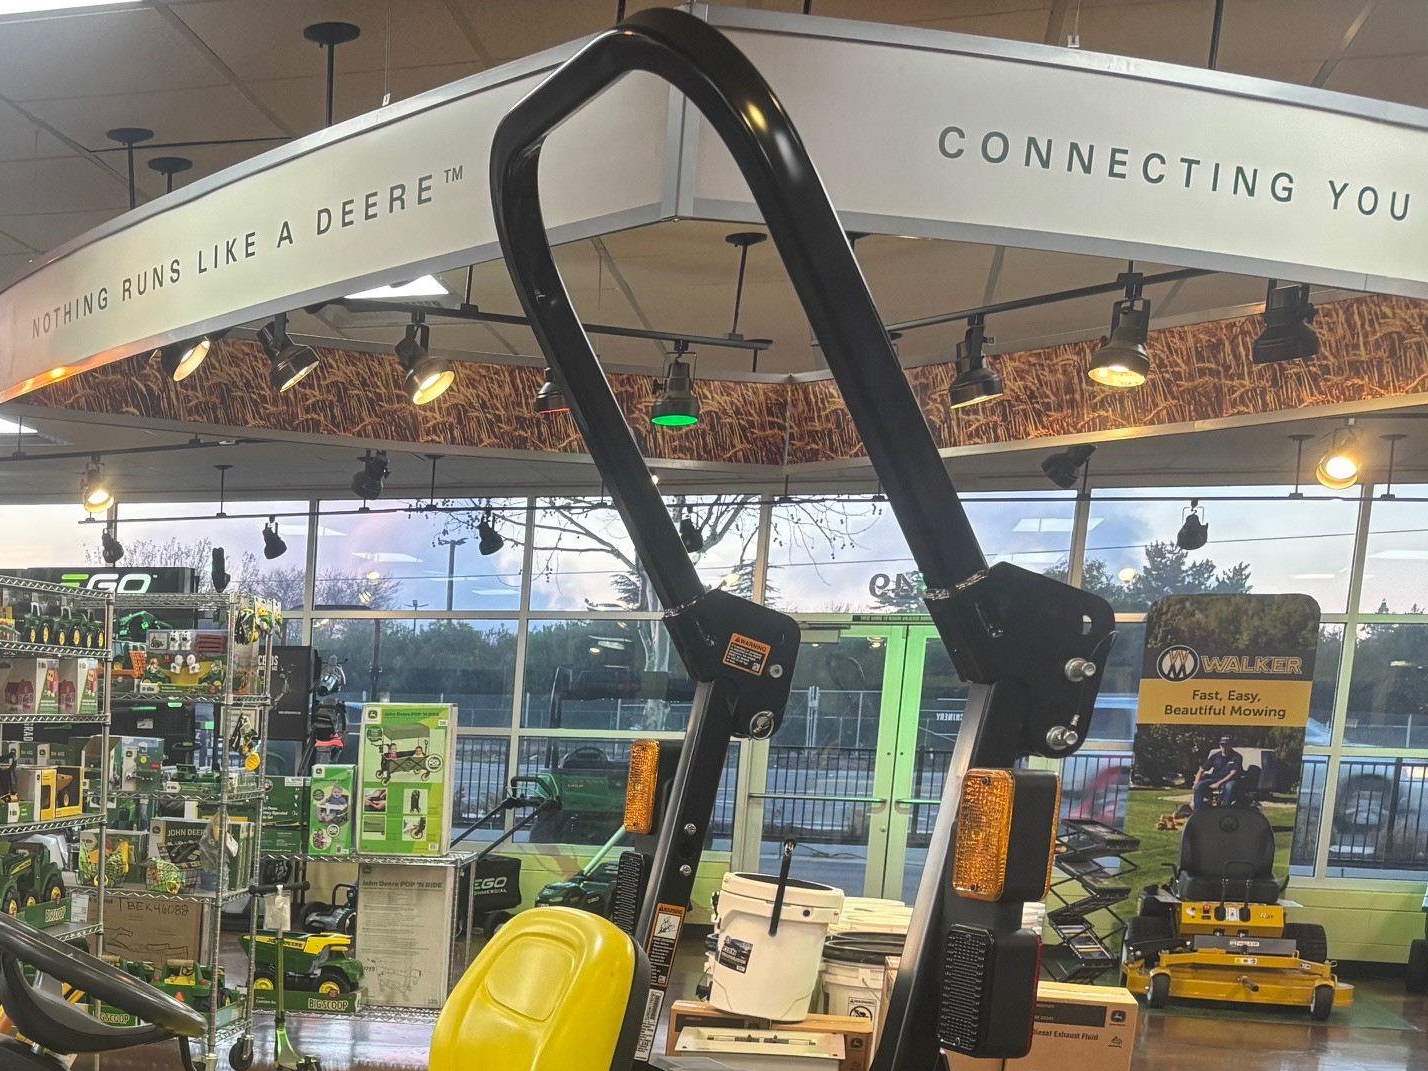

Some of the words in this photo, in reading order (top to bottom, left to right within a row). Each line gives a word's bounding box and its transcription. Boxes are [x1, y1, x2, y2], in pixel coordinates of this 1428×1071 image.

[937, 124, 1295, 203] CONNECTING
[1327, 178, 1411, 222] YOU
[31, 287, 109, 340] NOTHING
[122, 258, 181, 300] RUNS
[198, 231, 257, 275] LIKE
[276, 221, 294, 249] A
[61, 573, 153, 594] EGO
[740, 638, 767, 652] WARNING
[1201, 655, 1303, 675] WALKER
[1192, 689, 1223, 702] Fast,
[1227, 690, 1262, 704] Easy,
[1164, 704, 1226, 716] Beautiful
[1230, 705, 1287, 719] Mowing
[167, 828, 186, 836] JOHN
[187, 828, 205, 836] DEER
[474, 877, 507, 890] EGO
[474, 888, 507, 896] OMMERCIAL
[1054, 1030, 1080, 1040] Exhaust
